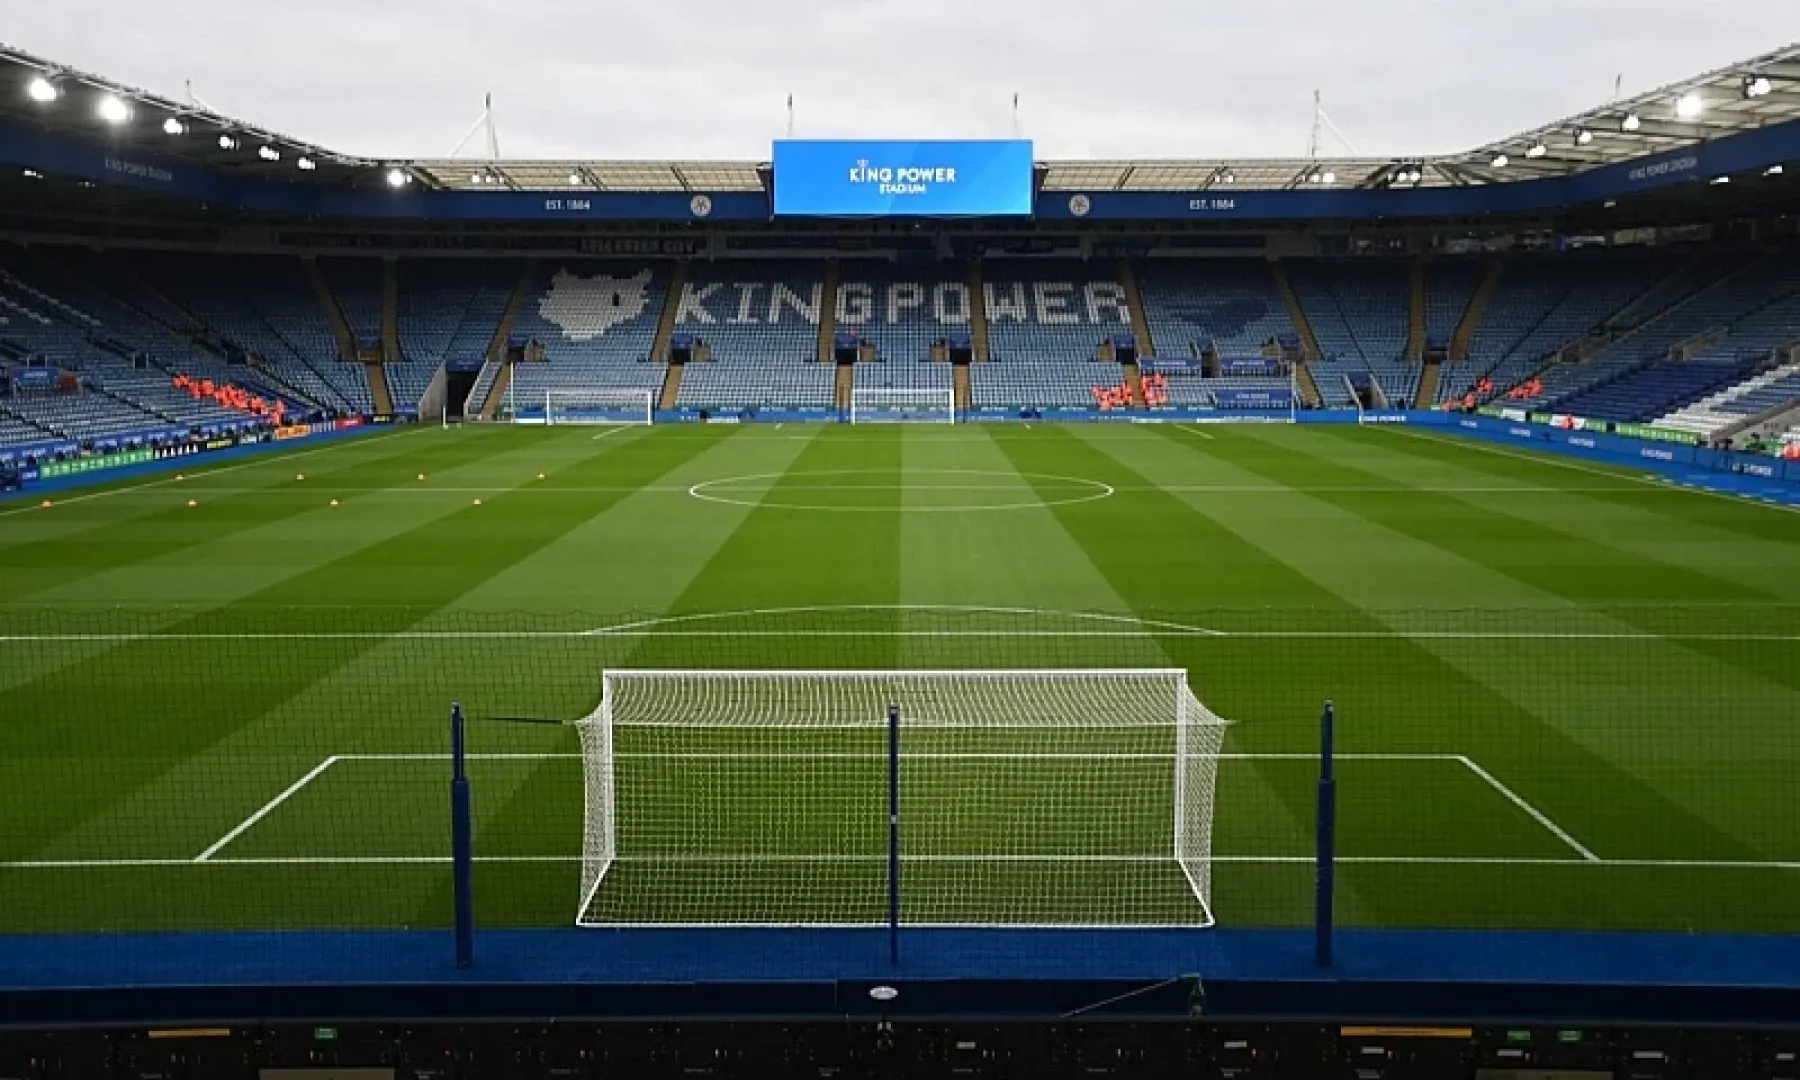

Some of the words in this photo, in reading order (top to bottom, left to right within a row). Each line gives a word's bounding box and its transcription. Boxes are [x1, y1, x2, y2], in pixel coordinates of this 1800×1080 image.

[850, 166, 892, 182] KING
[897, 167, 956, 182] POWER
[880, 183, 926, 194] STADIUM
[887, 282, 1132, 325] POWER
